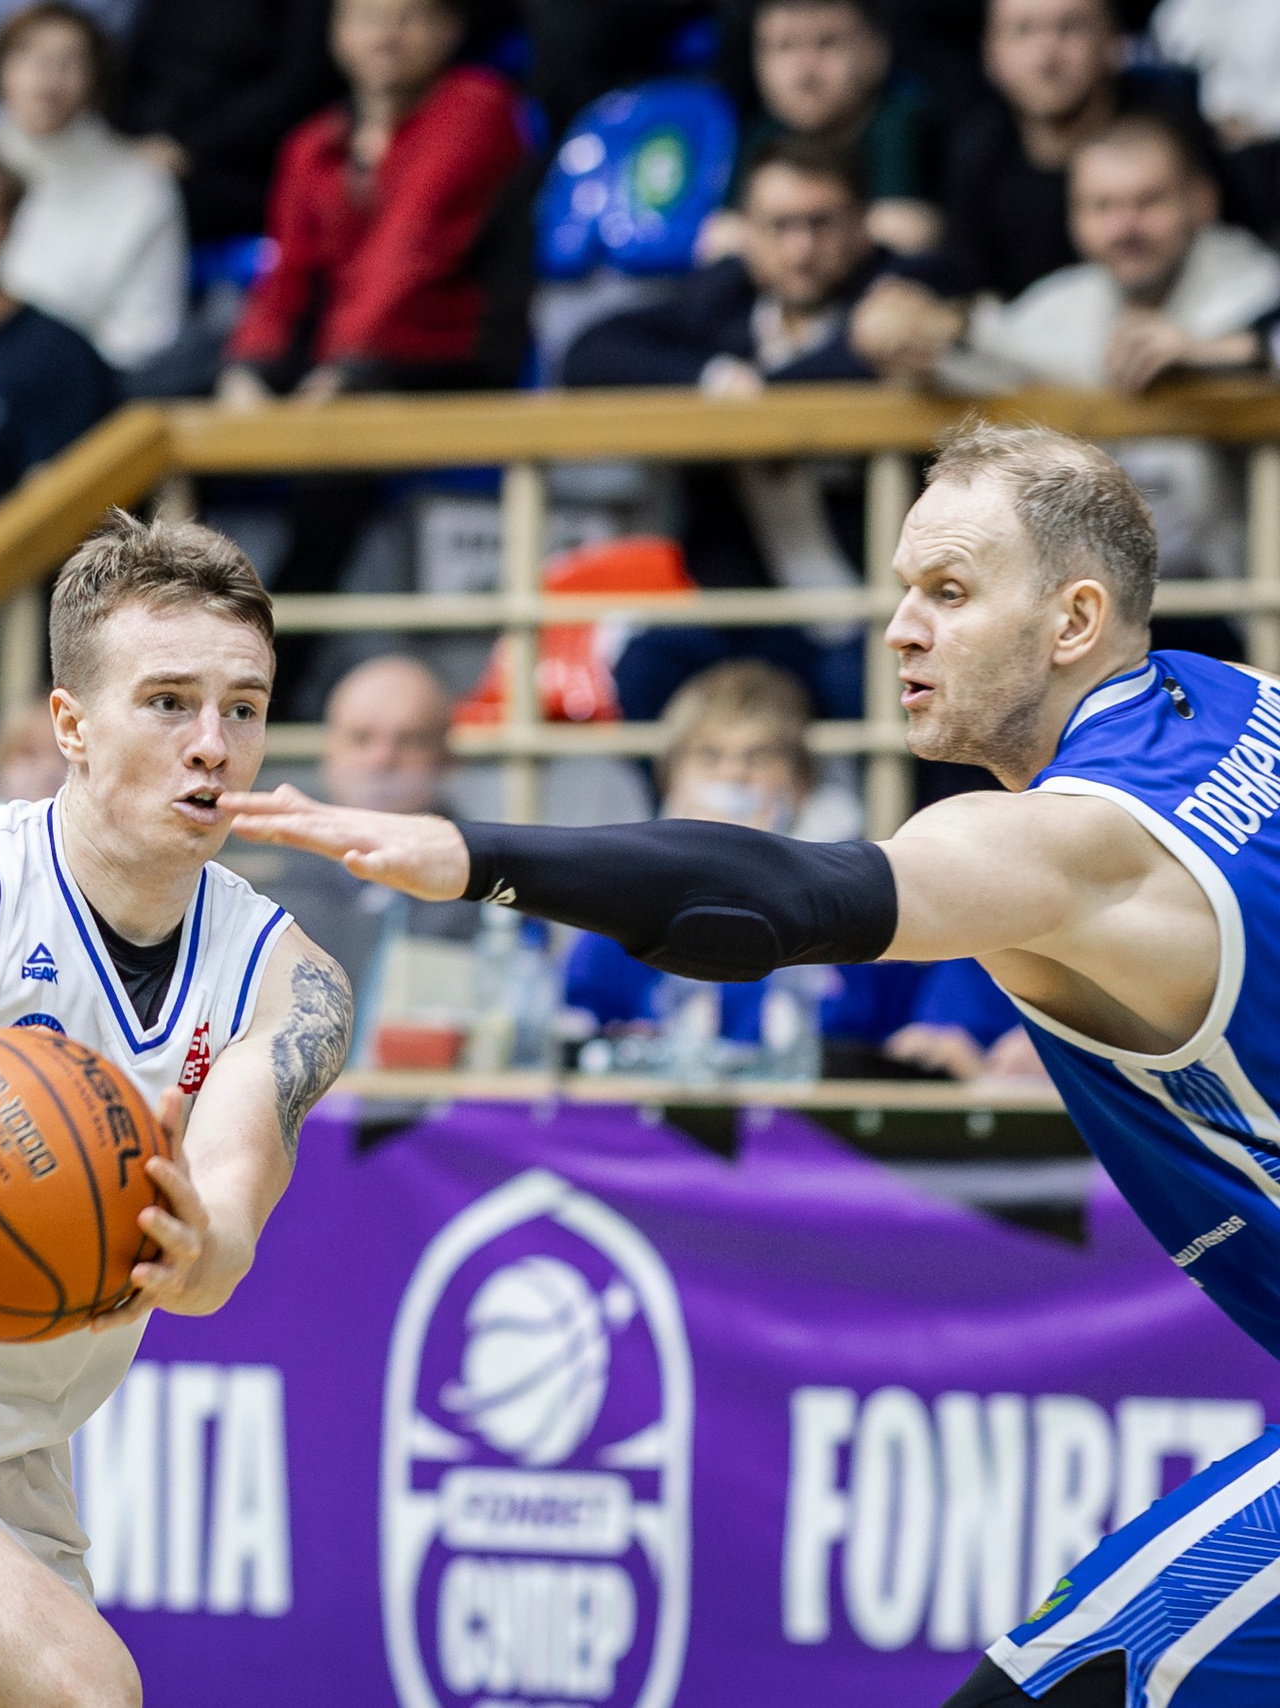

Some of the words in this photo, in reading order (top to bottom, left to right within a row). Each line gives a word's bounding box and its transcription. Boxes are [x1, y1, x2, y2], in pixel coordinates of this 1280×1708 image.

[1173, 680, 1280, 856] ПОНКРА
[21, 965, 59, 986] PEAK
[51, 1037, 143, 1190] OGEL
[80, 1361, 294, 1617] ИГА
[437, 1555, 637, 1700] СУПЕР
